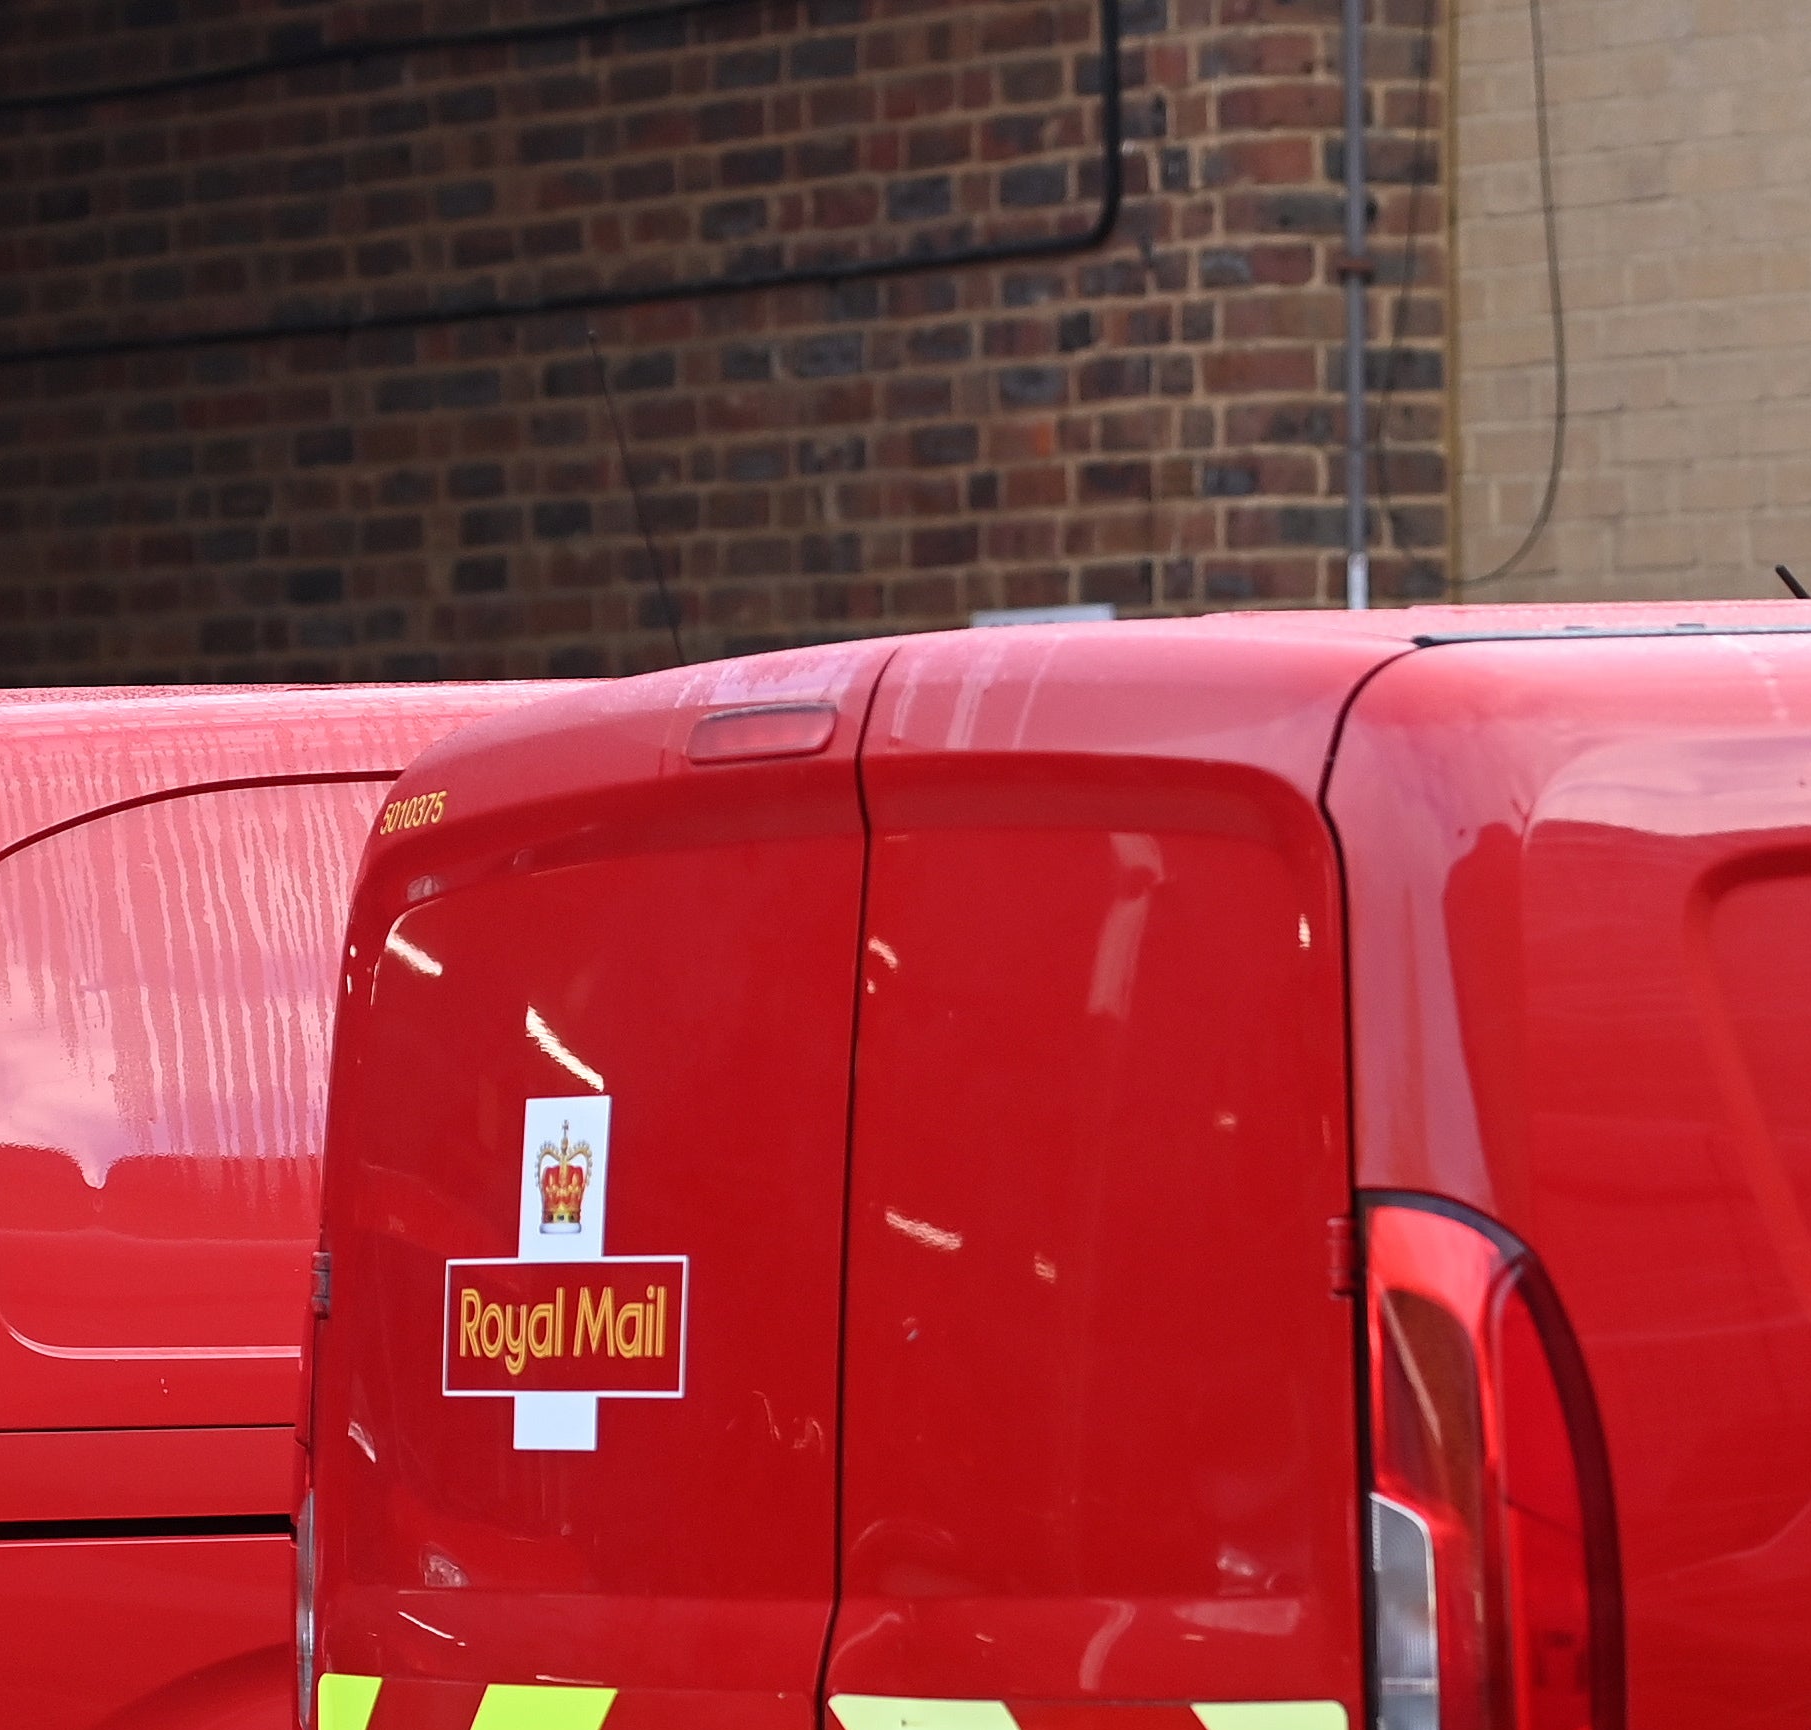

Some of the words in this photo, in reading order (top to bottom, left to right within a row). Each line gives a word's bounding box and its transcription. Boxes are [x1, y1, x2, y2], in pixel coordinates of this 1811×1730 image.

[379, 790, 448, 835] 5010375
[459, 1287, 565, 1376] Royal
[573, 1284, 668, 1358] Mail
